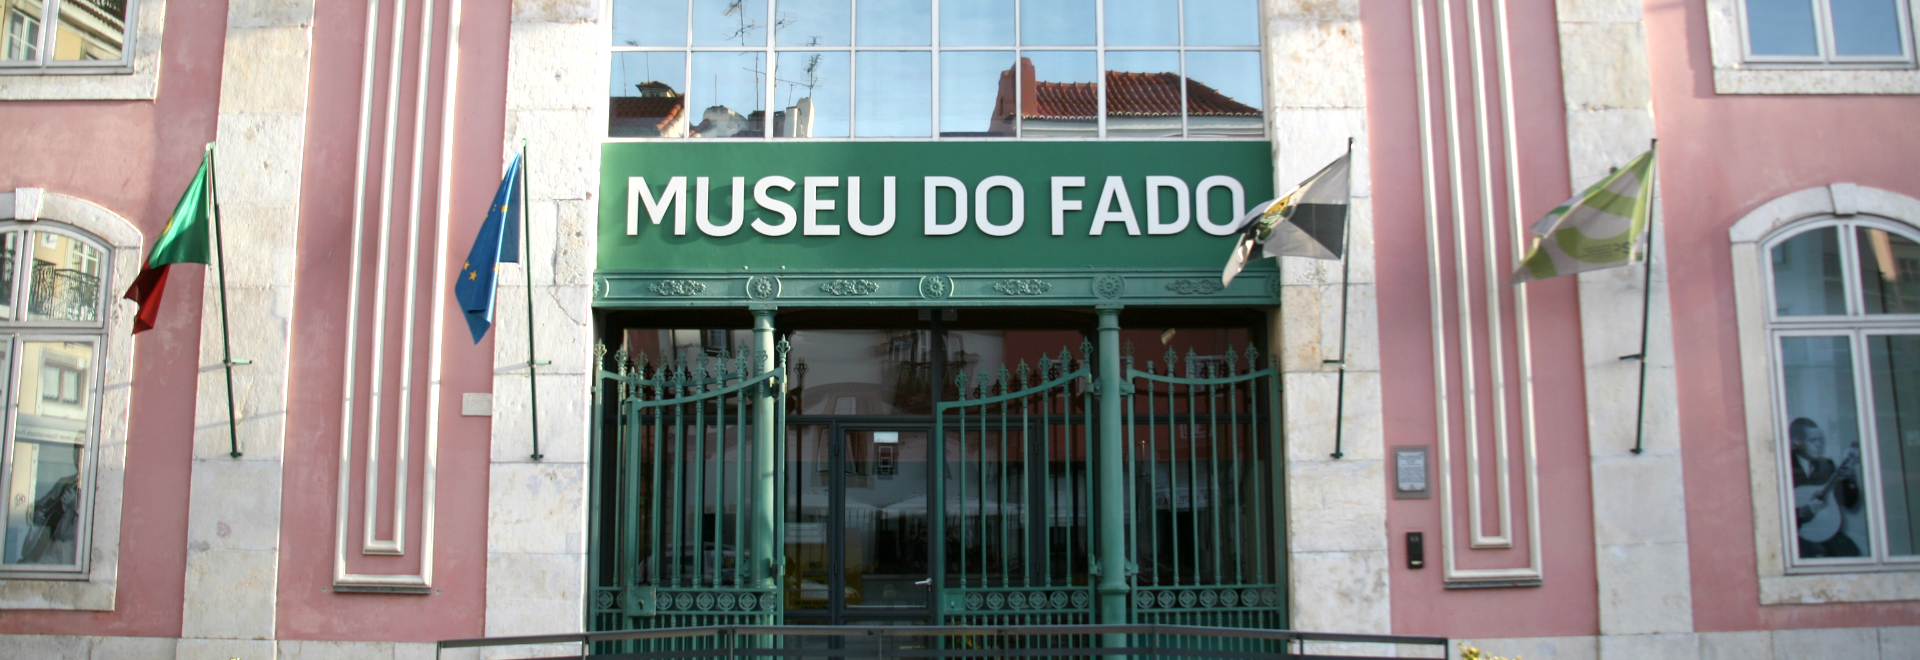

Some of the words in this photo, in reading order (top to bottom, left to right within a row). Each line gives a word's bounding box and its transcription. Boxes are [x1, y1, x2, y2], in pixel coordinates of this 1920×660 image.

[626, 175, 896, 237] MUSEU
[924, 175, 1025, 237] DO
[1051, 175, 1246, 236] FADO
